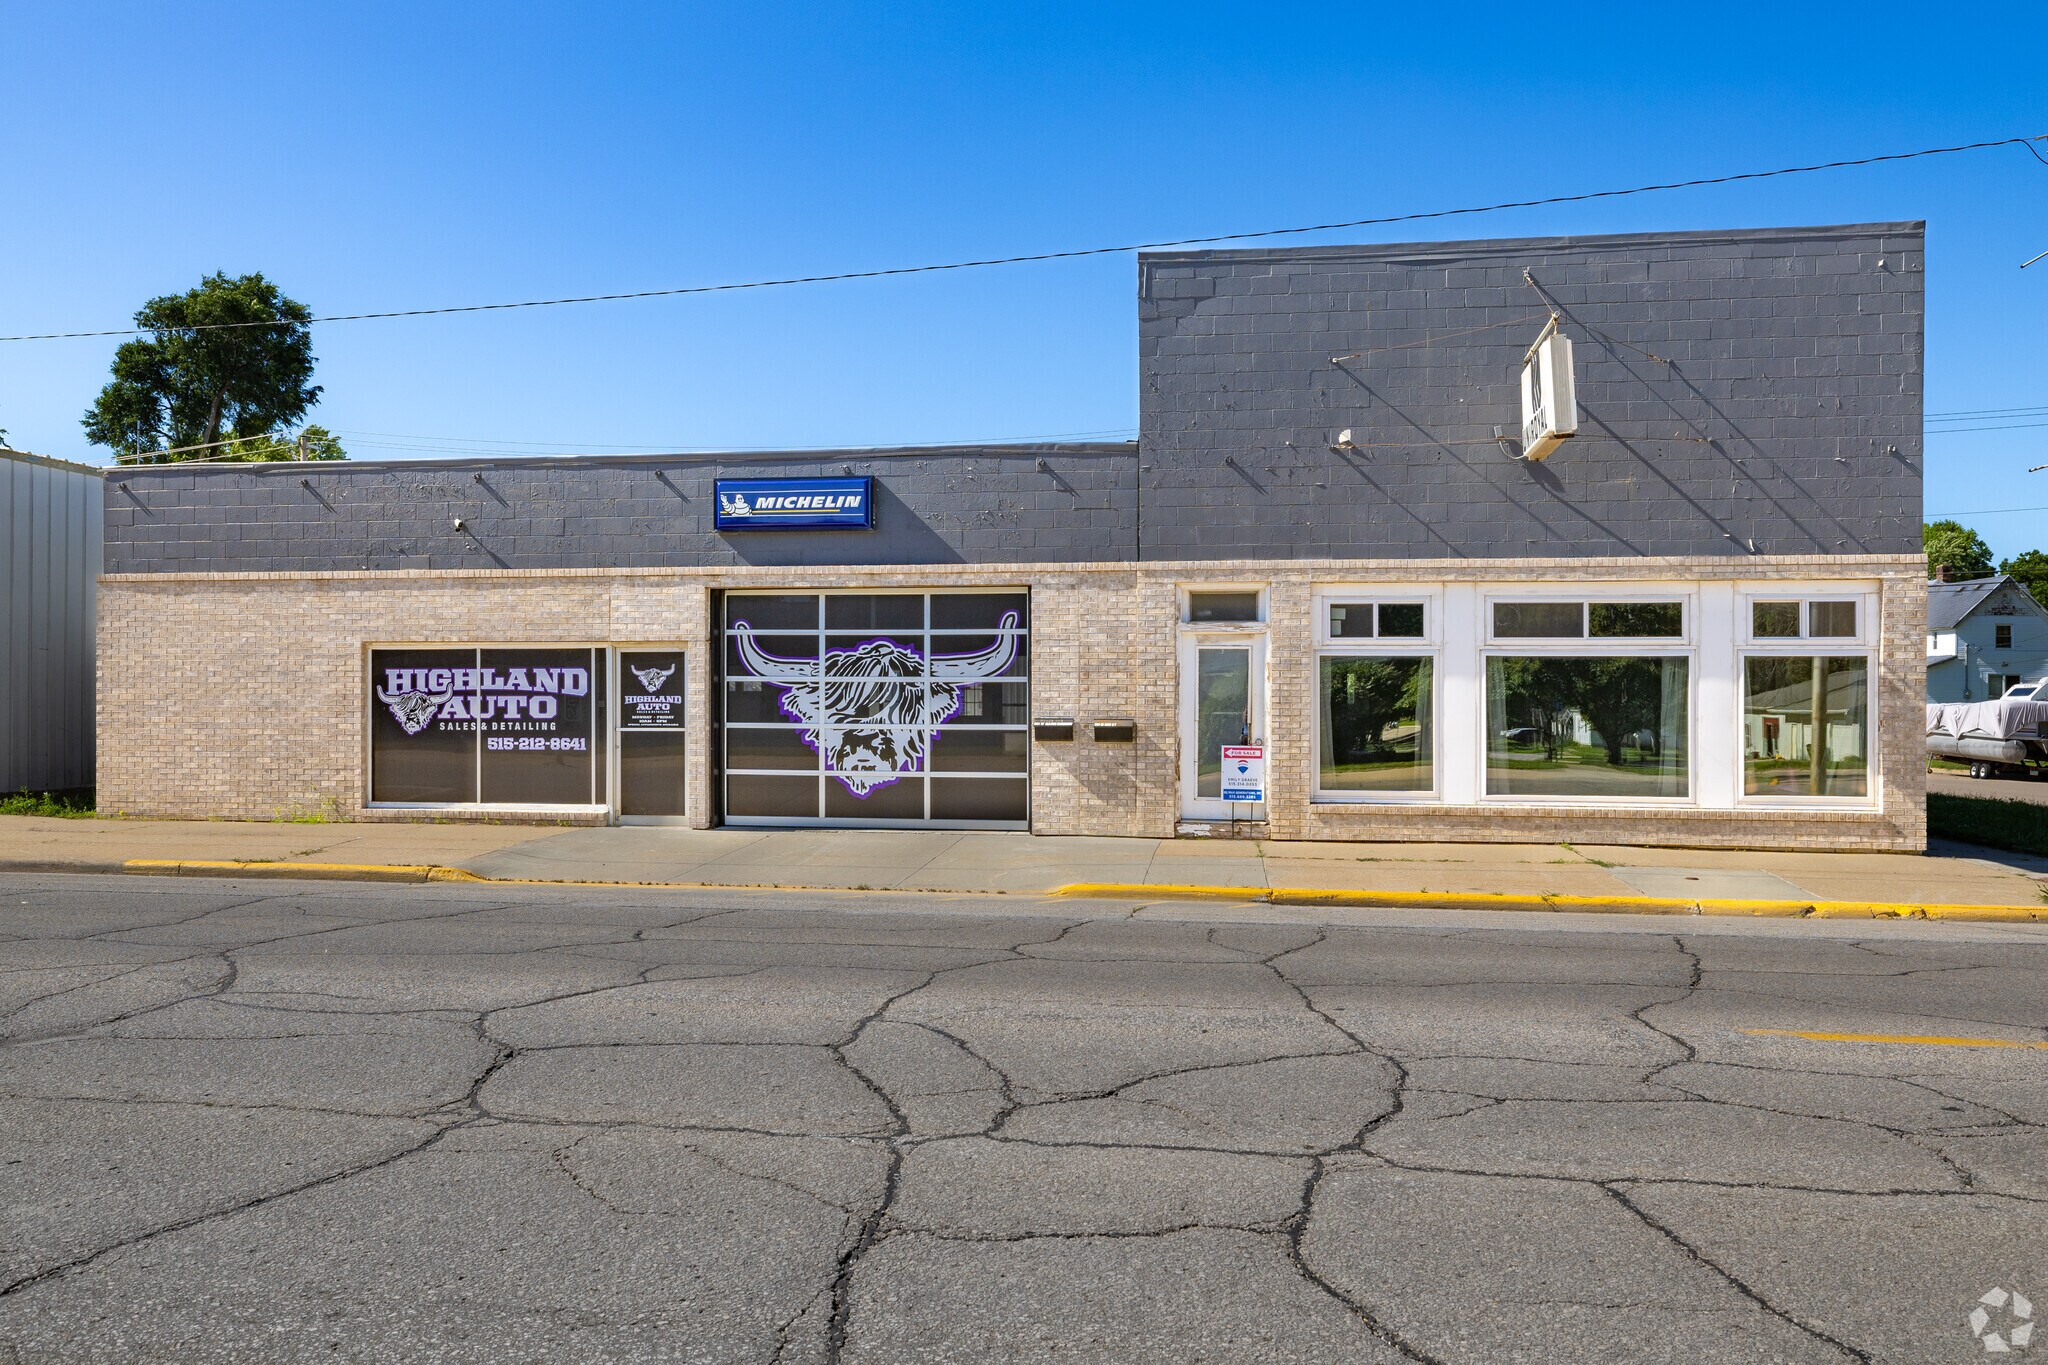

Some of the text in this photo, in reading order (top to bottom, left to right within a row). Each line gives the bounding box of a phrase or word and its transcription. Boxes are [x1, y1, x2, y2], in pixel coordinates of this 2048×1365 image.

[755, 495, 862, 509] MICHELIN
[384, 668, 589, 696] HIGHLAND
[624, 695, 682, 704] HIGHLAND
[437, 695, 558, 720] AUTO
[439, 721, 557, 731] SALES & DETAILING
[487, 737, 587, 751] 515-212-8641
